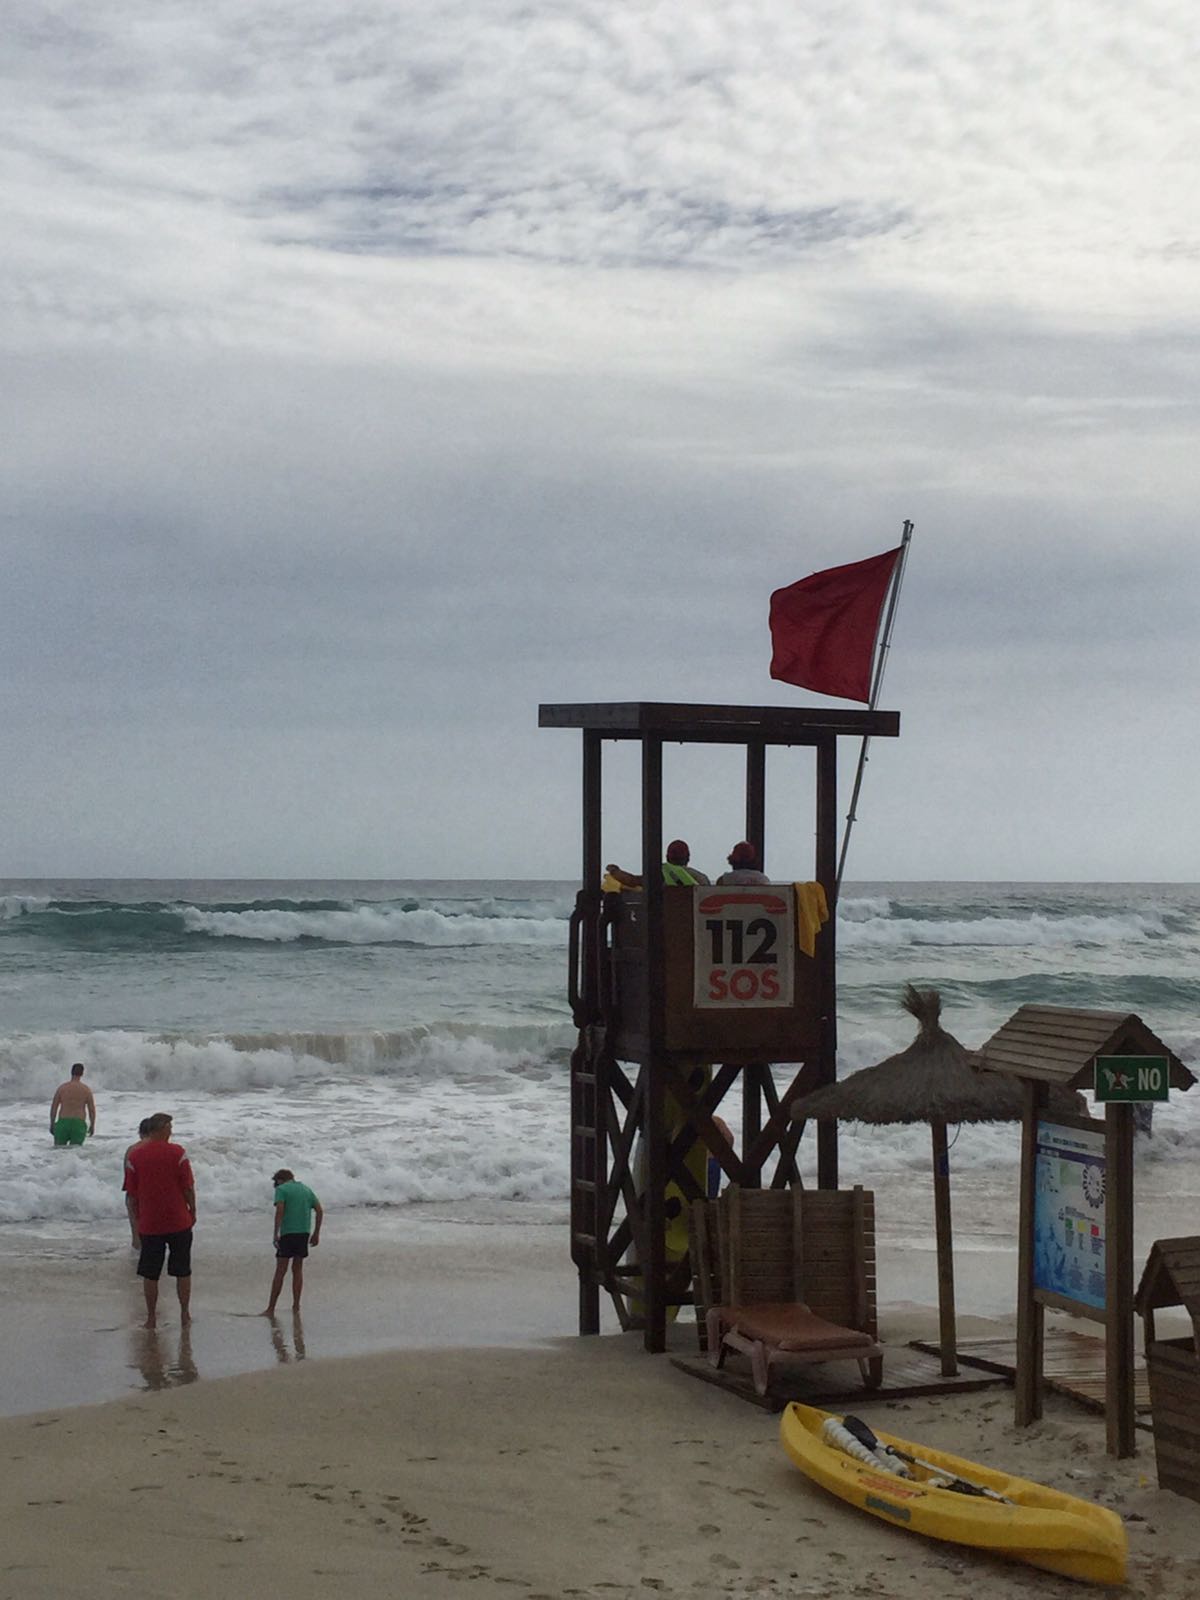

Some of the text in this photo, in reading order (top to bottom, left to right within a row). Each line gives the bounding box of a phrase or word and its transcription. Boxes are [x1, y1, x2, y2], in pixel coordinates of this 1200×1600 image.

[706, 918, 777, 964] 112
[708, 969, 780, 1000] SOS
[1138, 1068, 1161, 1091] NO
